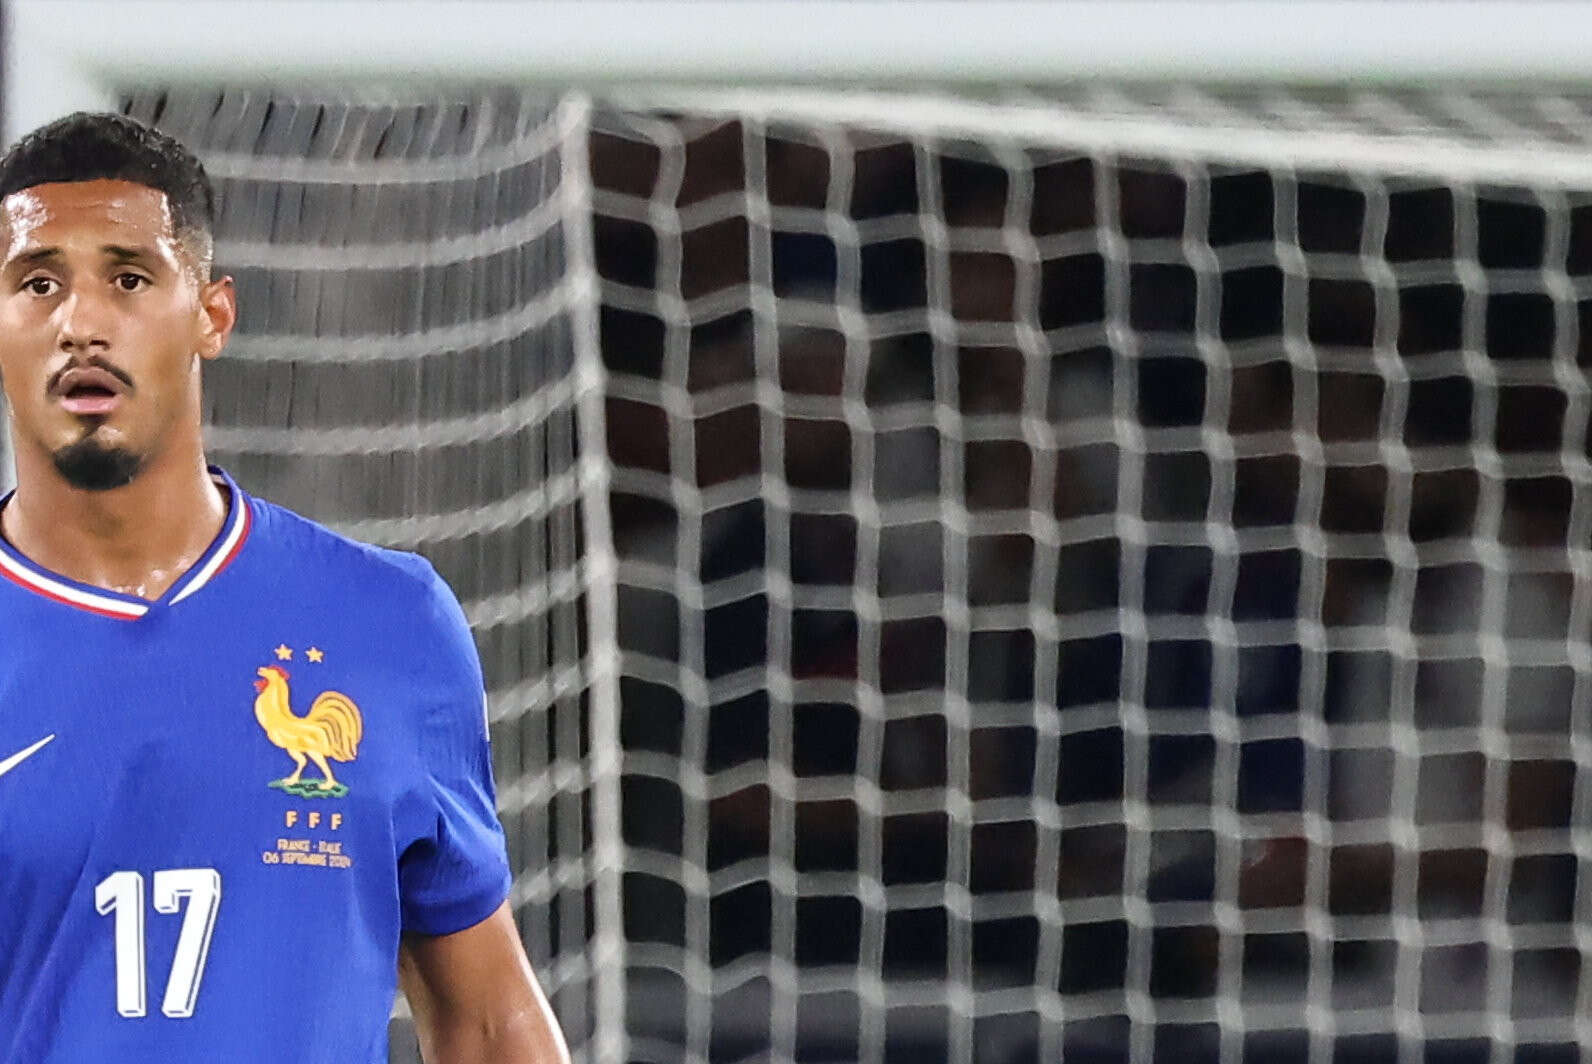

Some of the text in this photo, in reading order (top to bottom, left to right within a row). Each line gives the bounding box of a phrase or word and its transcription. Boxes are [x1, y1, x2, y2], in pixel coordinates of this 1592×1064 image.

[286, 811, 342, 830] F F F
[95, 868, 221, 1018] 17
